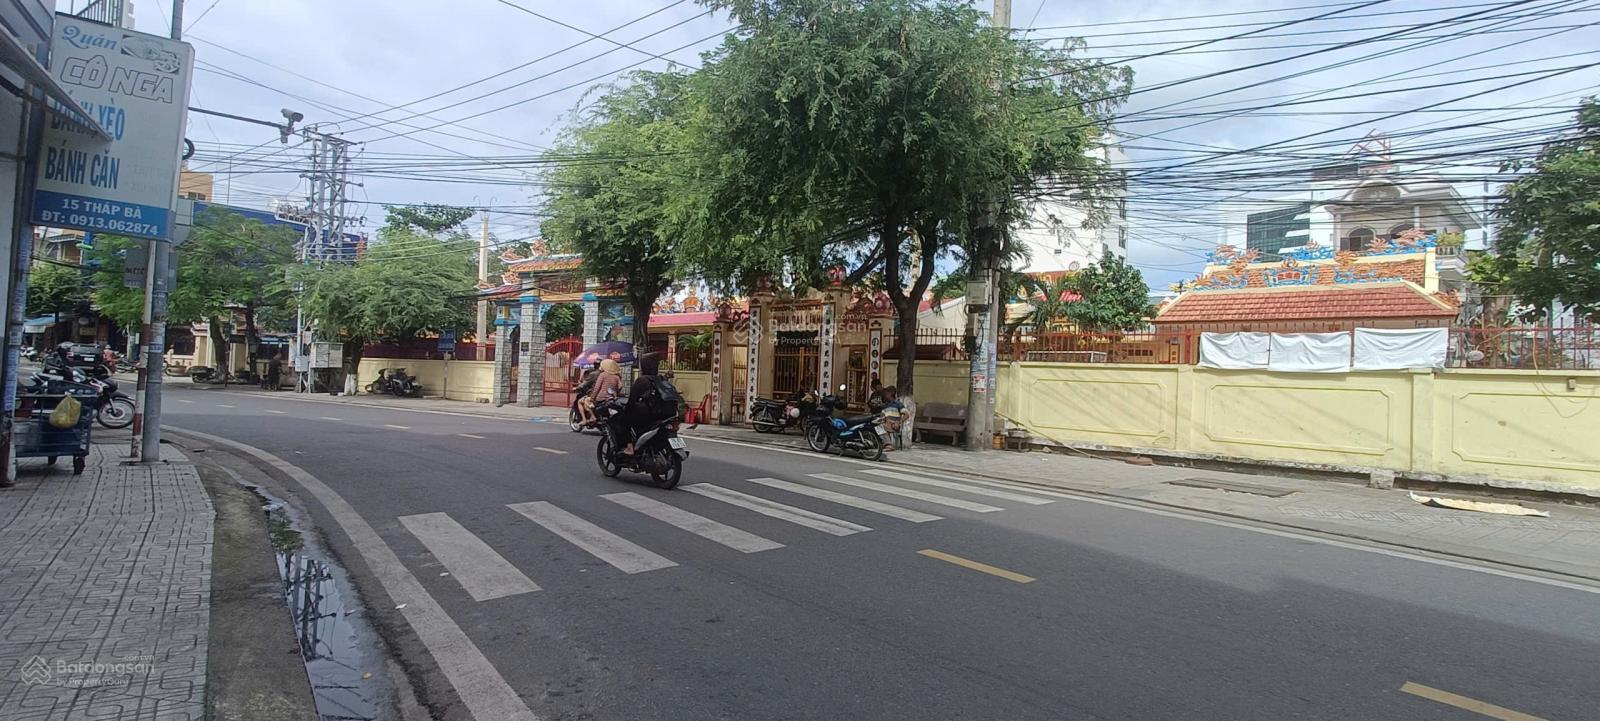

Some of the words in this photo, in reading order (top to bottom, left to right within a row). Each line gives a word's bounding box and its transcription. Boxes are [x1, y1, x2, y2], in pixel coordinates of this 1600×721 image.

[61, 25, 118, 50] Quán
[60, 54, 108, 89] CÔ
[108, 67, 173, 104] NGA
[44, 140, 88, 185] BÁNH
[90, 150, 121, 190] CĂN
[62, 198, 80, 210] 15
[83, 201, 121, 216] THÁP
[124, 206, 142, 220] BÀ
[41, 210, 66, 224] ĐT:
[69, 214, 159, 236] 0913.062874
